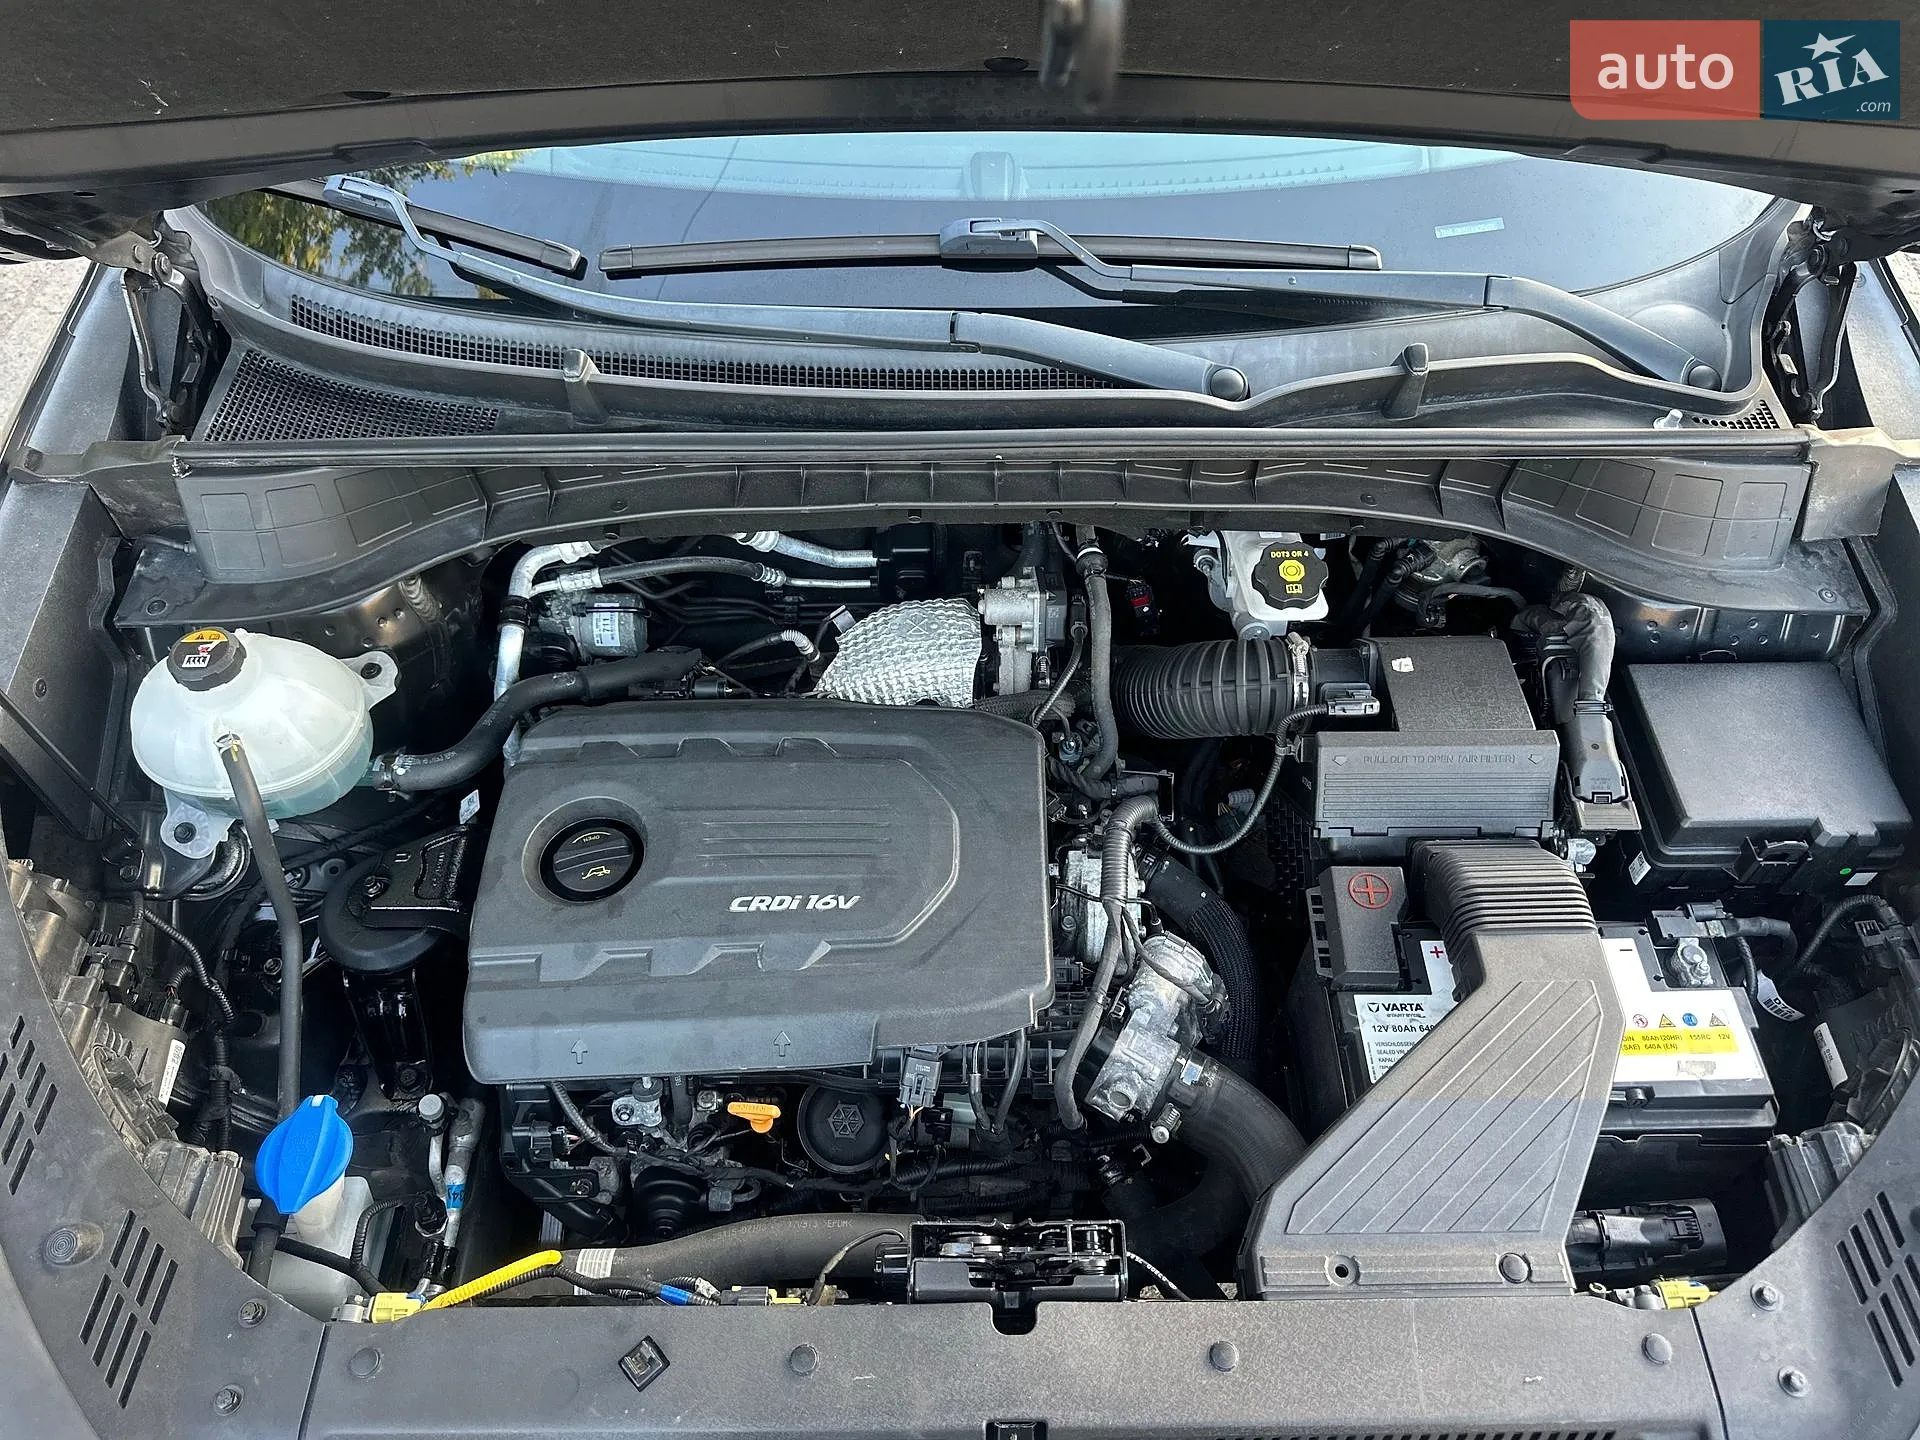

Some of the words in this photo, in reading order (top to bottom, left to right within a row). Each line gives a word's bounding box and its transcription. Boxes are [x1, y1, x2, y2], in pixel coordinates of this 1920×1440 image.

[1270, 551, 1291, 559] DOT3
[1291, 550, 1303, 558] OR
[1363, 754, 1389, 764] PULL
[1390, 754, 1409, 764] OUT
[1412, 754, 1425, 763] TO
[1427, 754, 1454, 763] OPEN
[728, 894, 803, 913] CRDi
[805, 894, 861, 911] 16V
[1381, 1002, 1425, 1012] VARTA
[1371, 1024, 1390, 1033] 12V
[1391, 1024, 1417, 1033] 80Ah
